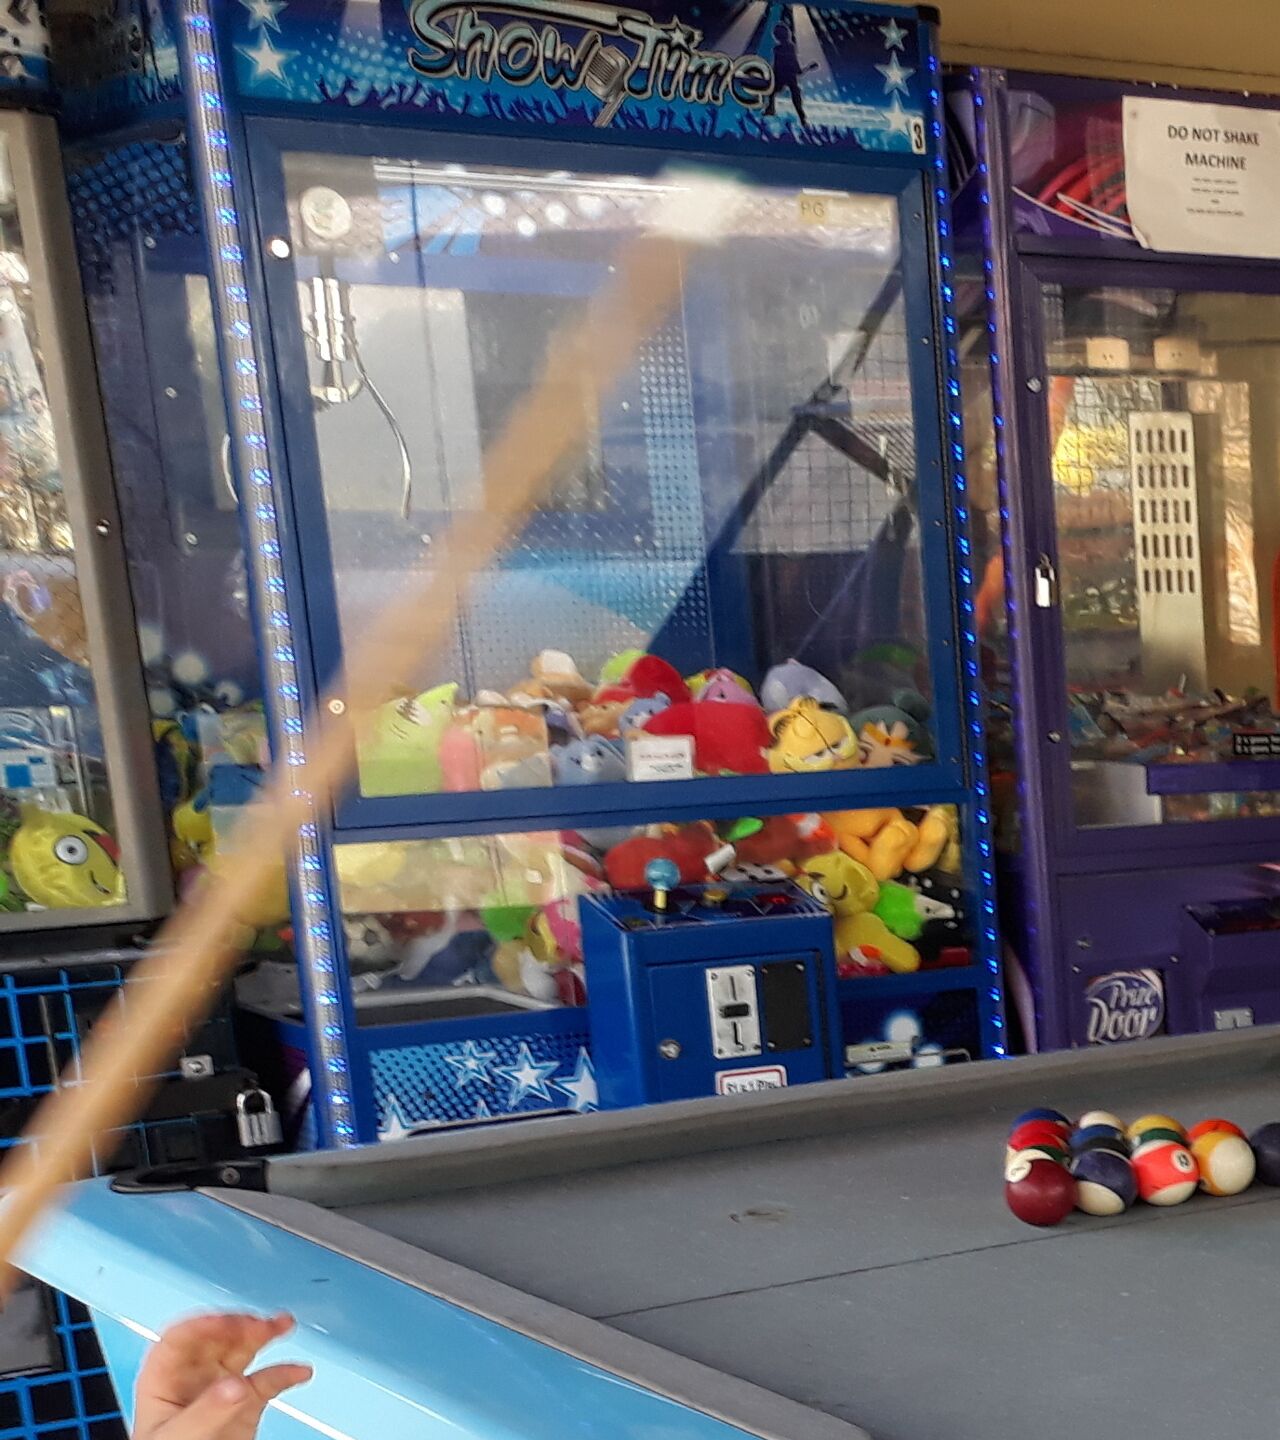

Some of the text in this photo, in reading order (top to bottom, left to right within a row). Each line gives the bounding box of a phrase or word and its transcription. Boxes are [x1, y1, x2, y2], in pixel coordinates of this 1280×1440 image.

[912, 121, 923, 149] 3
[1167, 124, 1260, 147] DO NOT SHAKE
[1185, 152, 1247, 171] MACHINE
[1087, 998, 1157, 1043] Door
